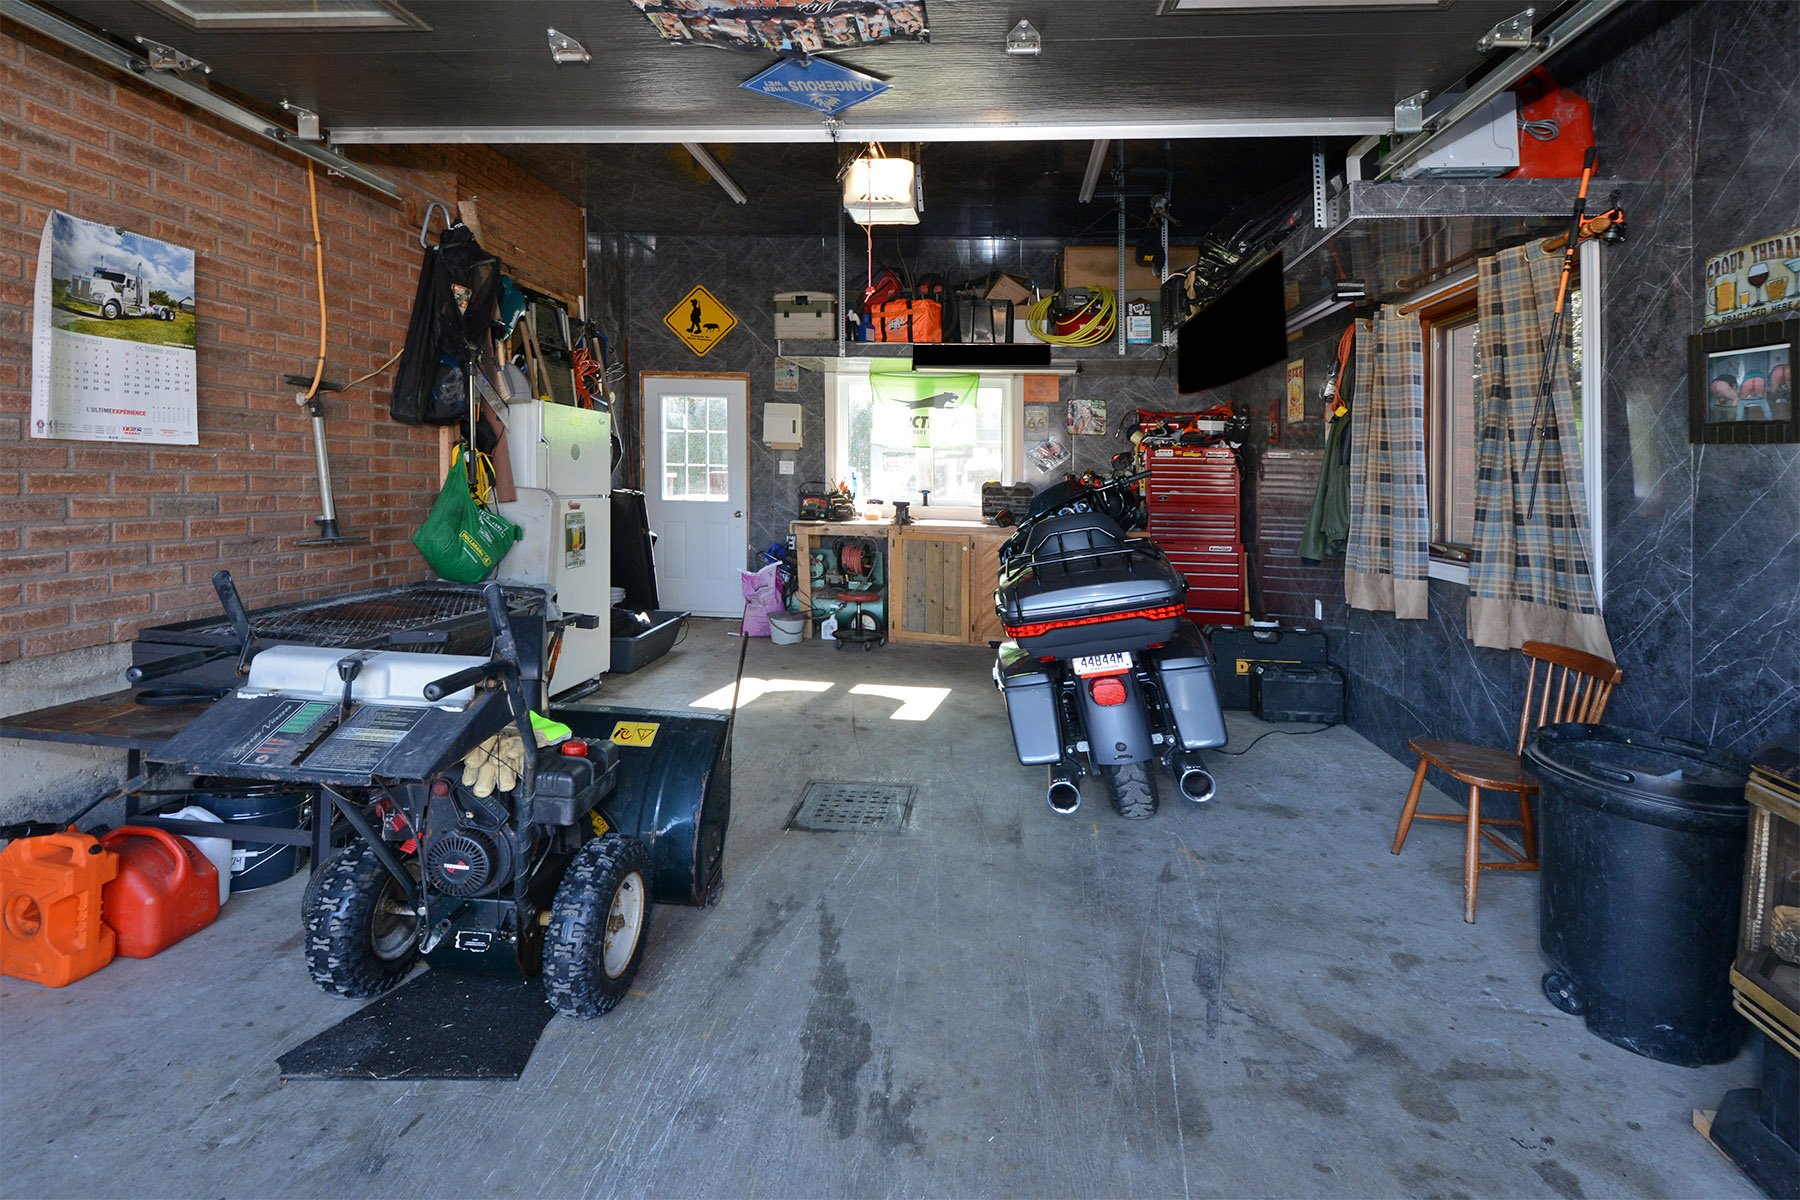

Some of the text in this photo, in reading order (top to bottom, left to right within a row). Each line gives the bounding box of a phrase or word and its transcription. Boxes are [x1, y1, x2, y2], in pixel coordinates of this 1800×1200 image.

[788, 80, 874, 92] DANGEROUS
[1706, 251, 1744, 288] GROUP
[1721, 301, 1793, 324] PRACTICED HERE
